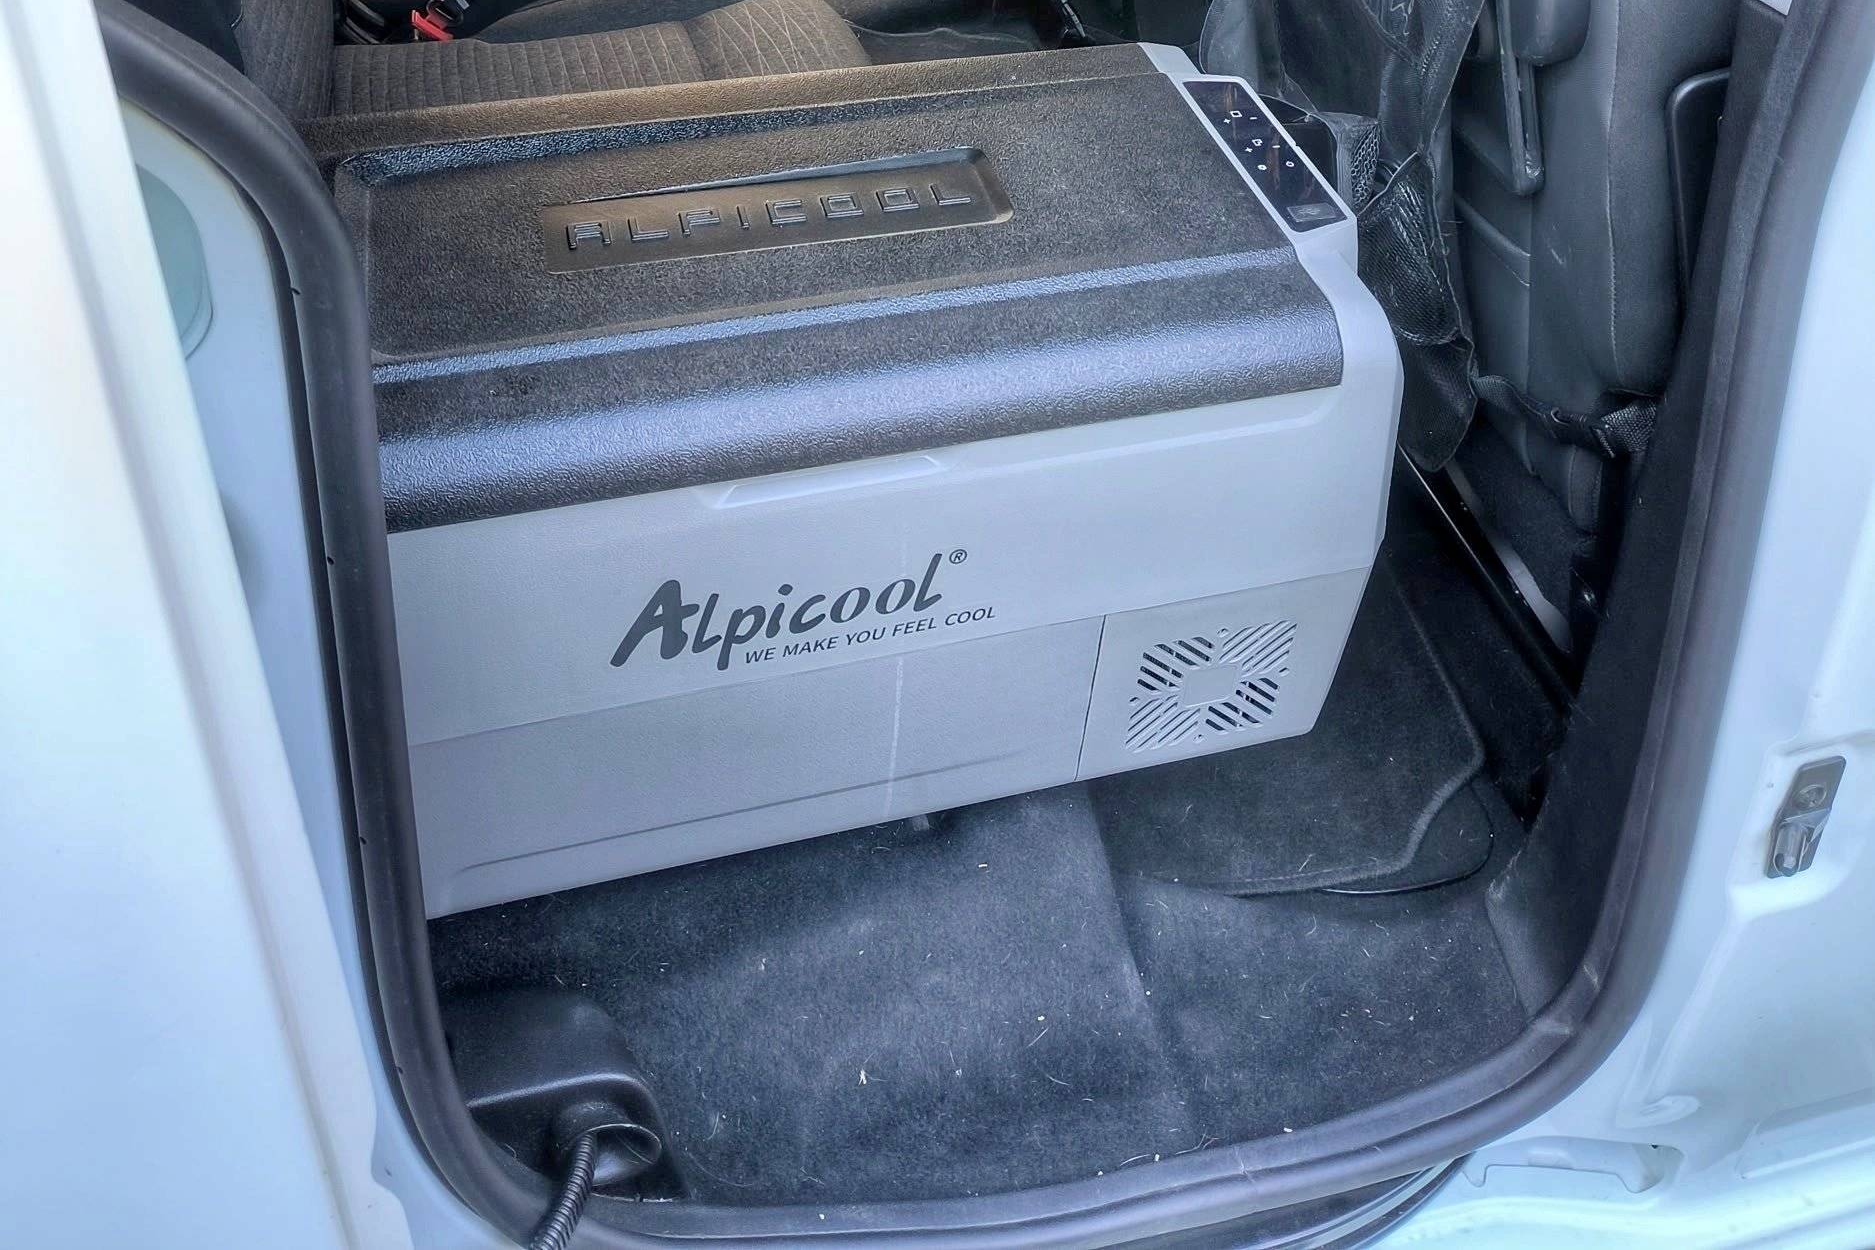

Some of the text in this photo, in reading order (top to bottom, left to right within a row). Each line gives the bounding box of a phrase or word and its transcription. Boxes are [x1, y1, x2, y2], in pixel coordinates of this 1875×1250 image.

[567, 182, 972, 250] ALPICOOL
[744, 606, 996, 665] WE MAKE YOU FEEL COOL
